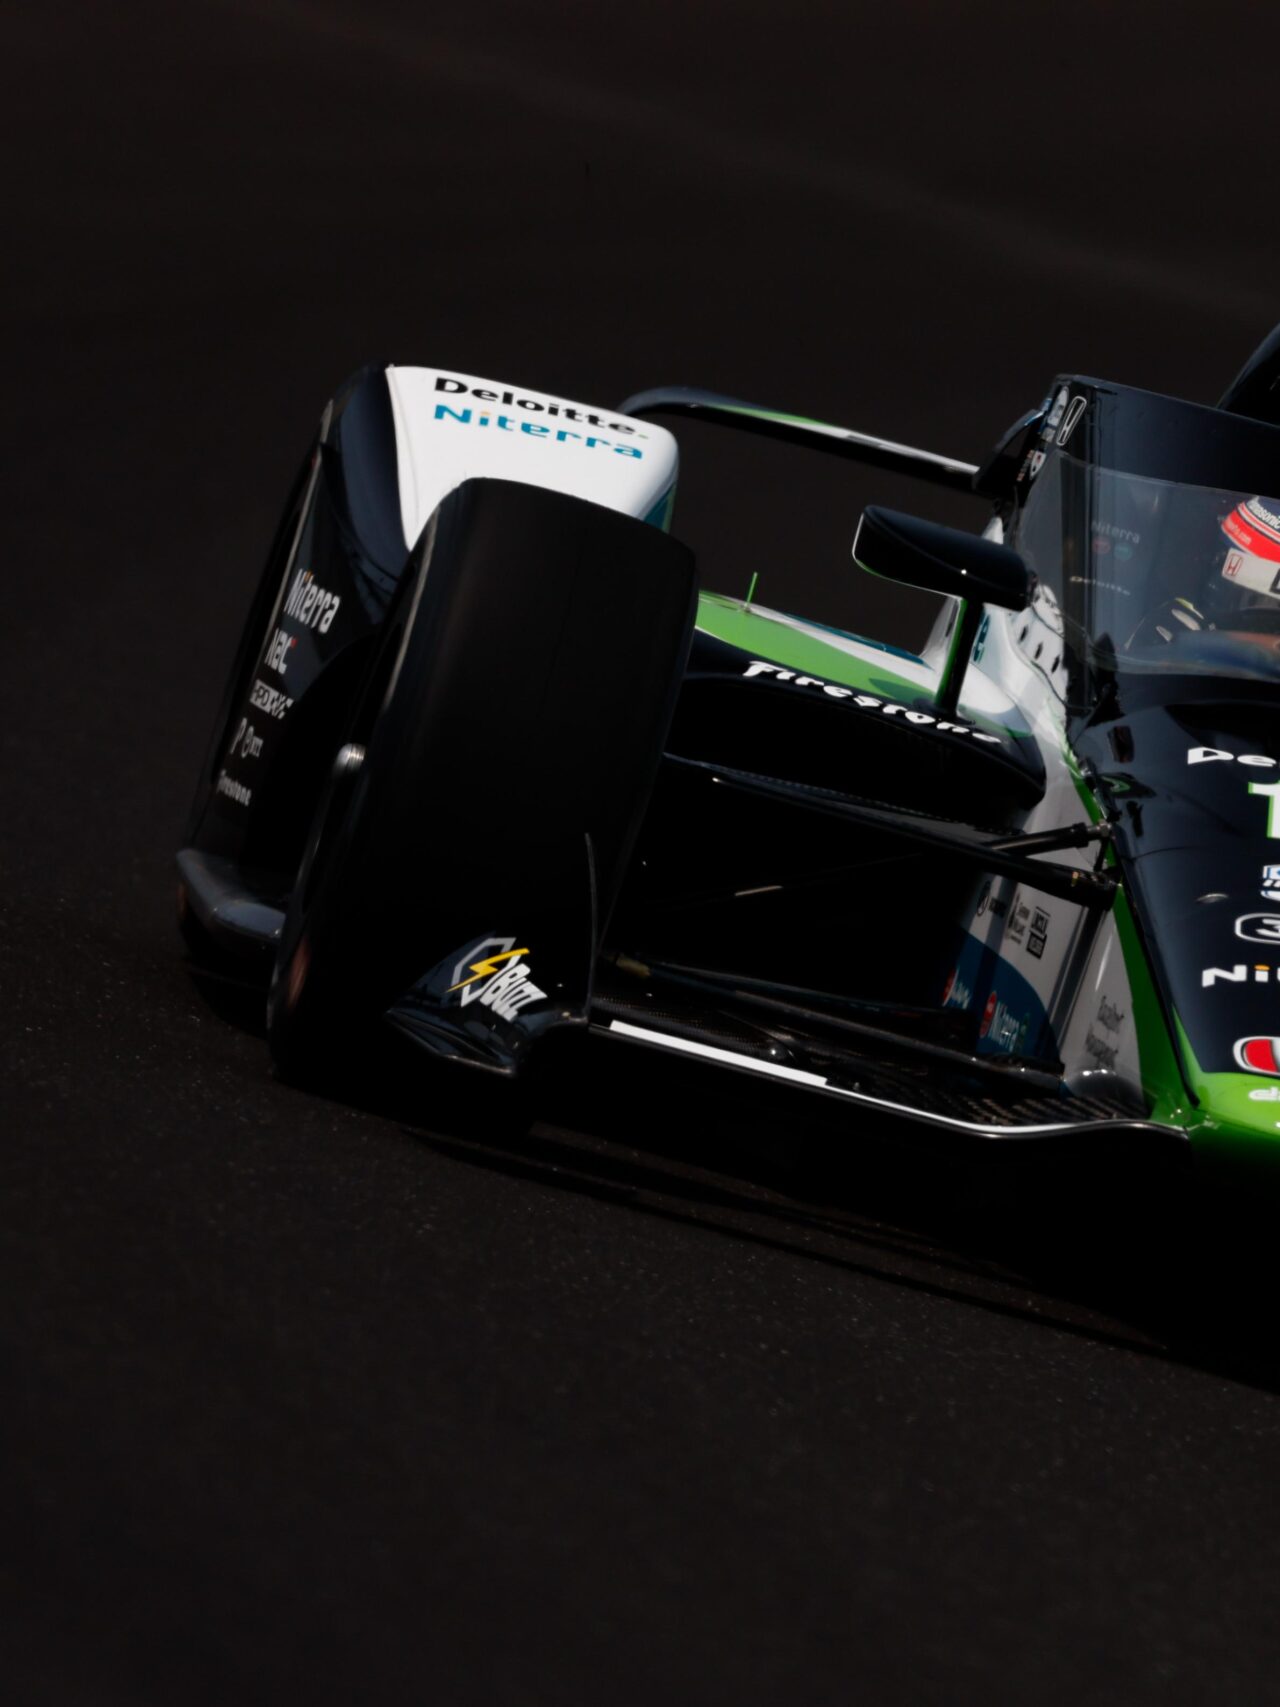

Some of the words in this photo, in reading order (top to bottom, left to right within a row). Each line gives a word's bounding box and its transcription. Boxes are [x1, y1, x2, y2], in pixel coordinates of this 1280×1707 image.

[434, 377, 649, 440] Deloitte.
[434, 404, 643, 460] Niterra
[283, 568, 341, 634] Niterra
[743, 660, 1002, 744] Firestone
